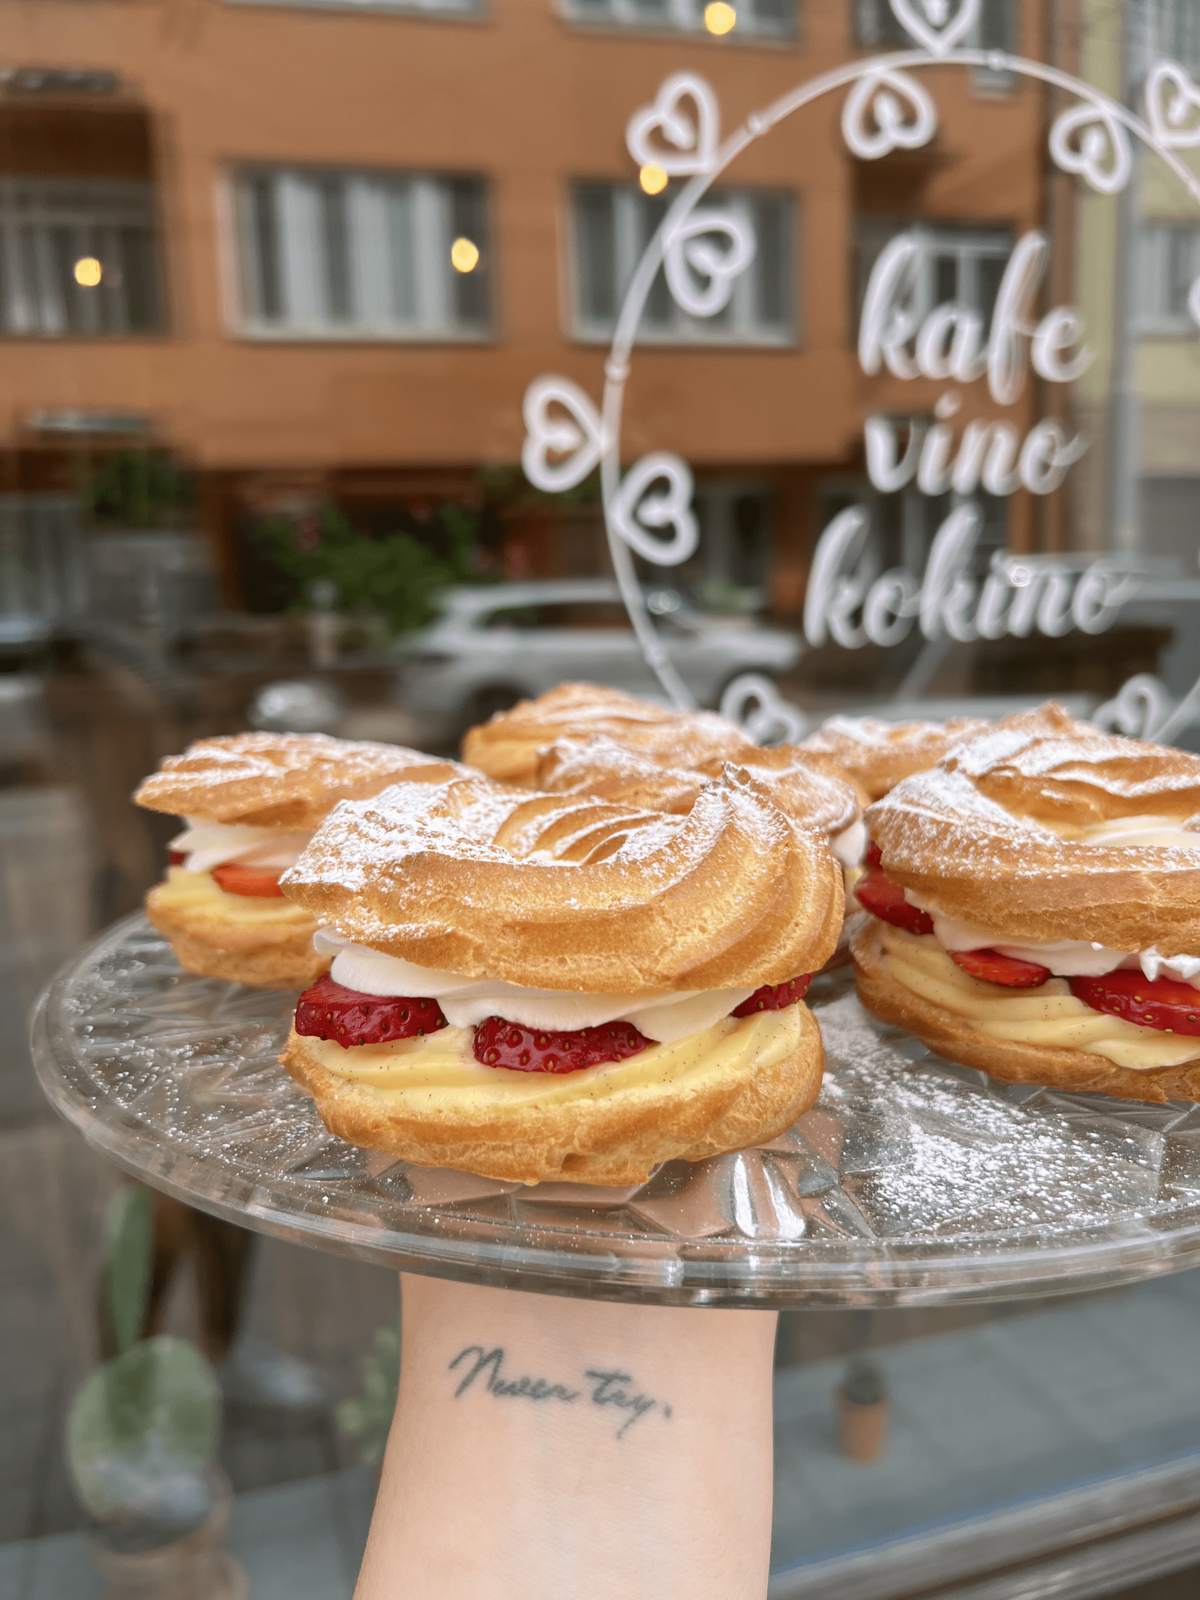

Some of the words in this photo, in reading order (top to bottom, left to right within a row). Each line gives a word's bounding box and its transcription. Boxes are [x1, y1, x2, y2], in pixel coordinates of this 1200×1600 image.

[858, 230, 1095, 406] kafe
[863, 391, 1093, 497] vino
[803, 504, 1140, 649] kokino
